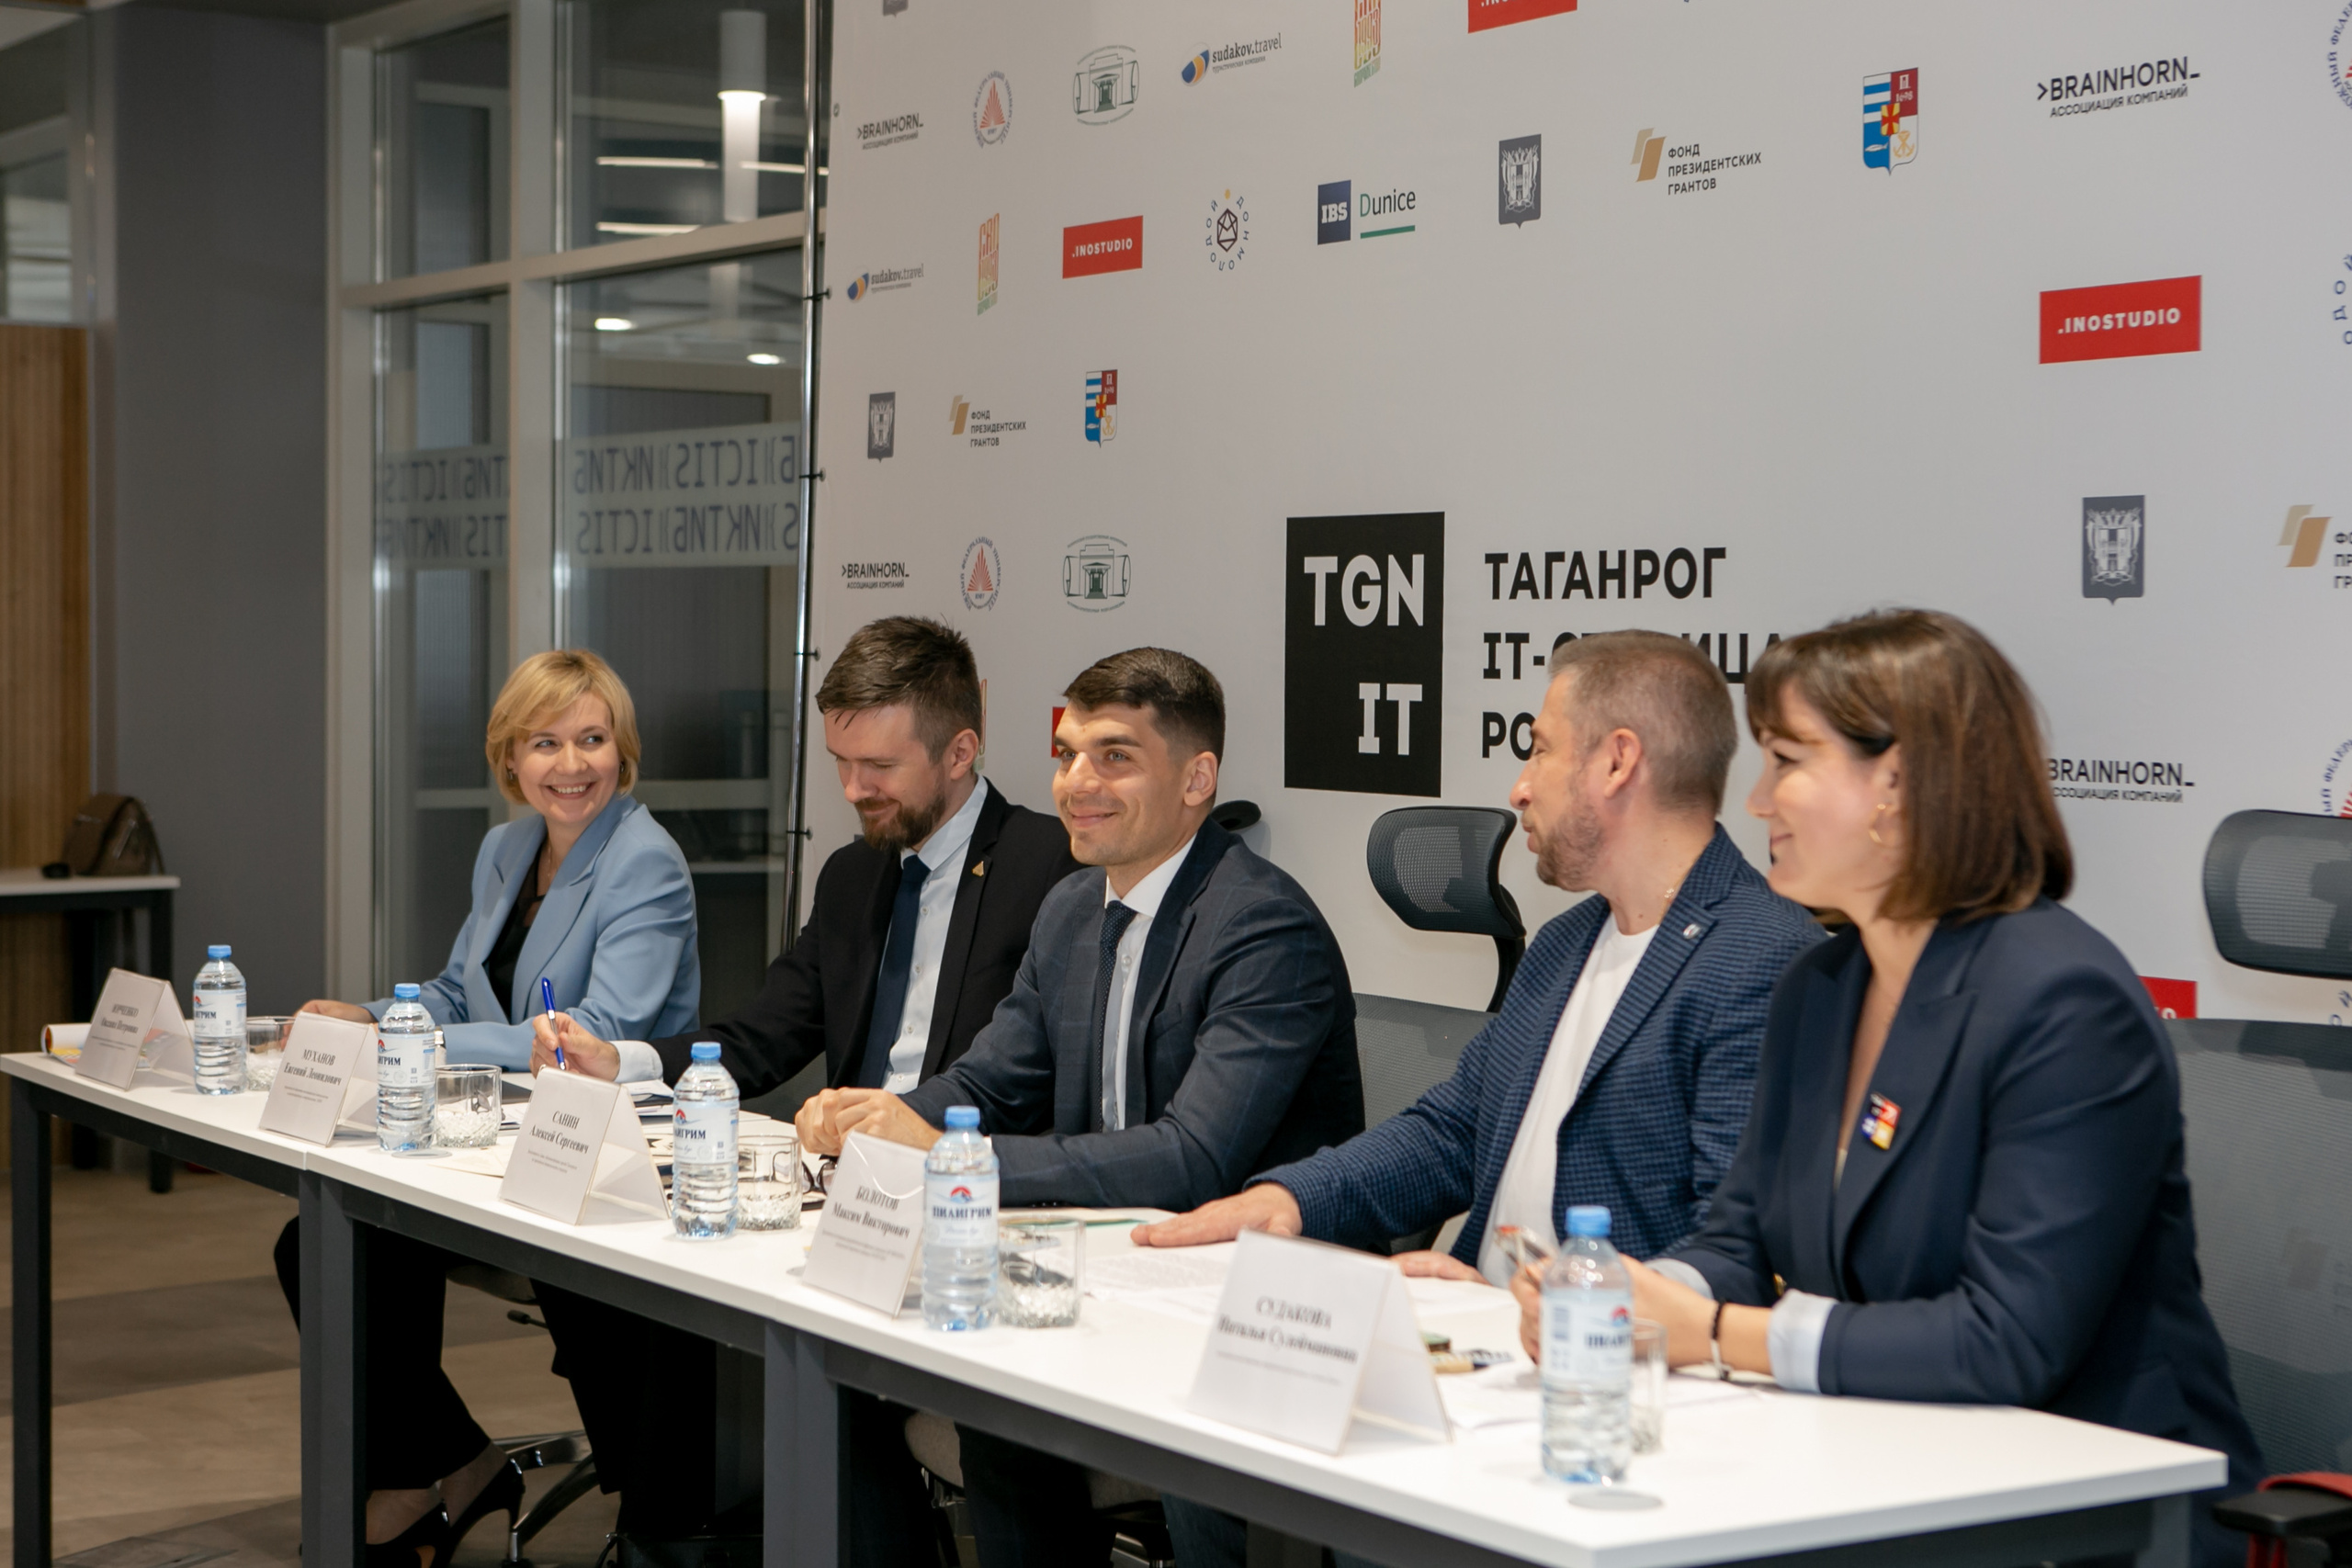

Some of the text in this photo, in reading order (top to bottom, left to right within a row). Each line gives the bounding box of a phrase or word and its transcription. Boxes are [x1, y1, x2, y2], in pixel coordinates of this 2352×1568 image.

[1212, 32, 1282, 63] sudakov.travel
[2050, 84, 2188, 118] АССОЦИАЦИЯ КОМПАНИЙ
[1668, 143, 1701, 158] ФОНД
[1668, 152, 1762, 177] ПРЕЗИДЕНТСКИХ
[1668, 177, 1717, 196] ГРАНТОВ
[1321, 188, 1416, 224] IBS Dunice
[870, 263, 925, 285] sudakov.travel
[2057, 308, 2181, 334] .INOSTUDIO
[970, 410, 991, 422] ФОНД
[970, 421, 1027, 434] ПРЕЗИДЕНТСКИХ
[970, 437, 1000, 448] ГРАНТОВ
[1484, 547, 1726, 600] ТАГАНРОГ
[1304, 554, 1424, 627] TGN
[1358, 682, 1422, 755] IT
[2052, 786, 2184, 803] ССОЦИАЦИЯ КОМПАНИЙ
[284, 1062, 308, 1077] Евгений
[301, 1049, 336, 1066] МУХАНОВ
[552, 1111, 581, 1130] САНИН
[529, 1124, 589, 1154] Алексей Сергеевич
[855, 1185, 900, 1212] БОЛОТОВ
[832, 1202, 910, 1240] Максим Викторович
